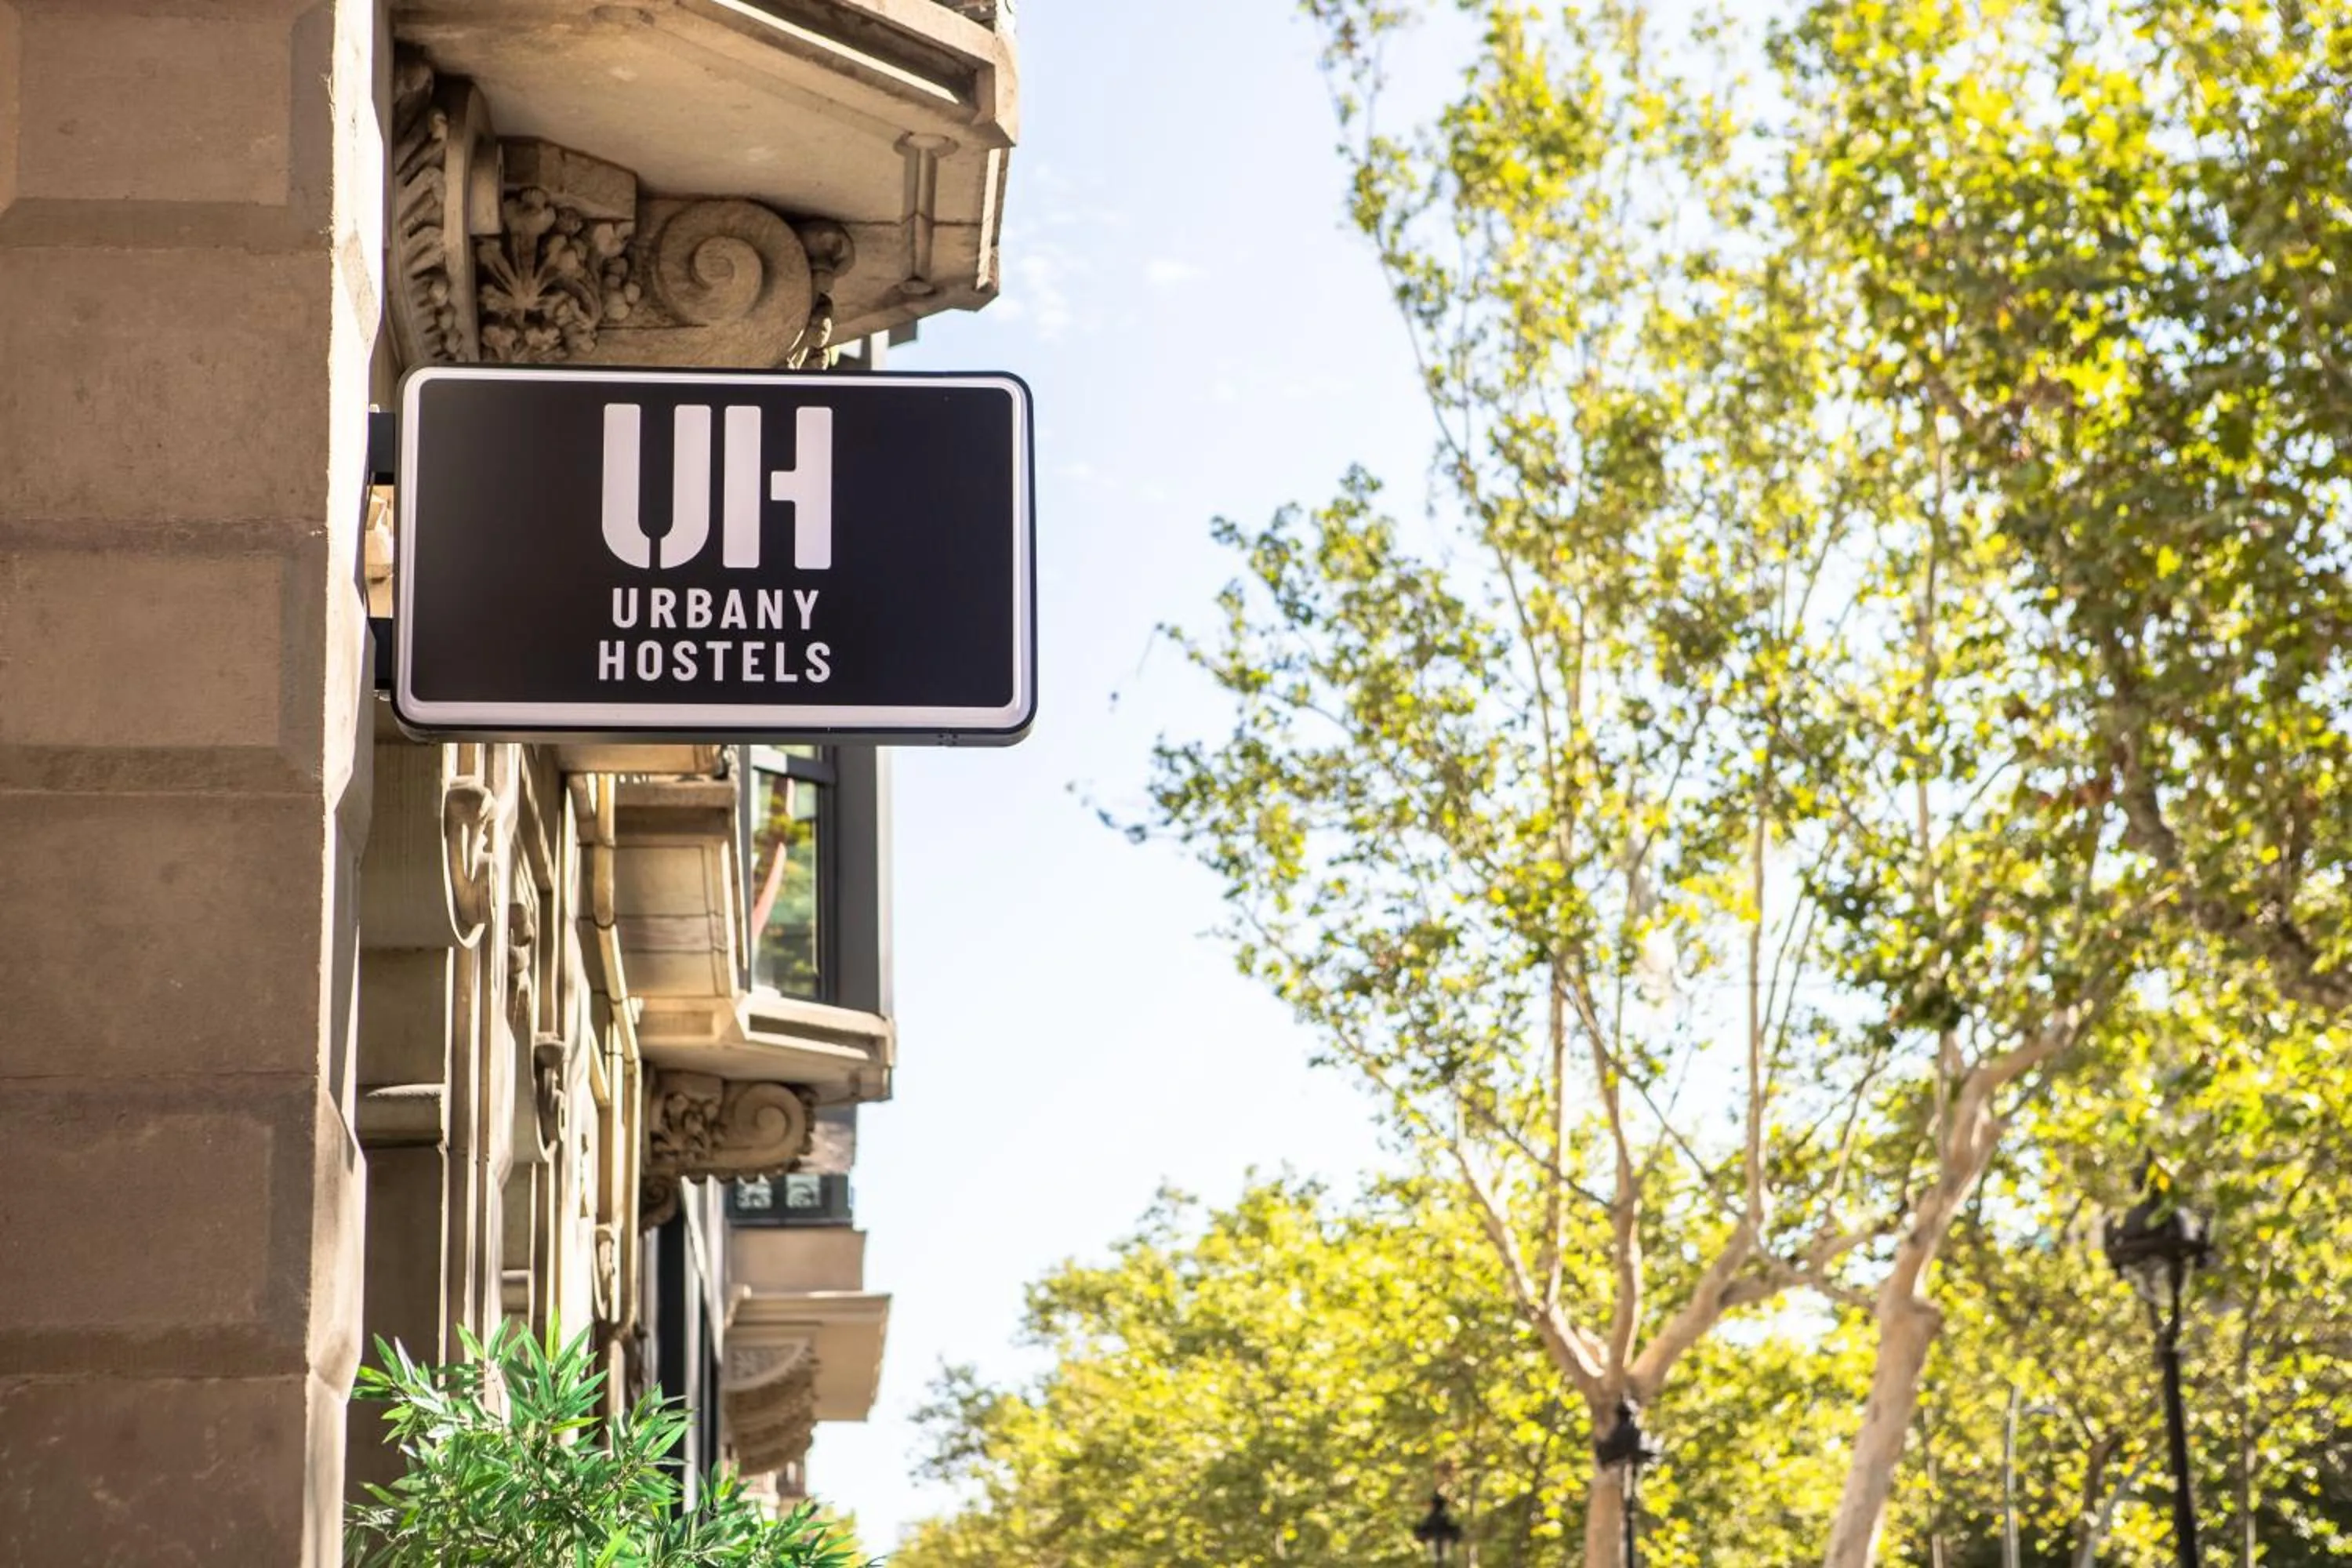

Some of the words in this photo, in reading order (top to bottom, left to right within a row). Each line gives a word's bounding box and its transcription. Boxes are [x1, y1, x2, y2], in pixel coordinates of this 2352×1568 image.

[601, 403, 833, 570] UH
[612, 587, 820, 630] URBANY
[597, 639, 831, 684] HOSTELS
